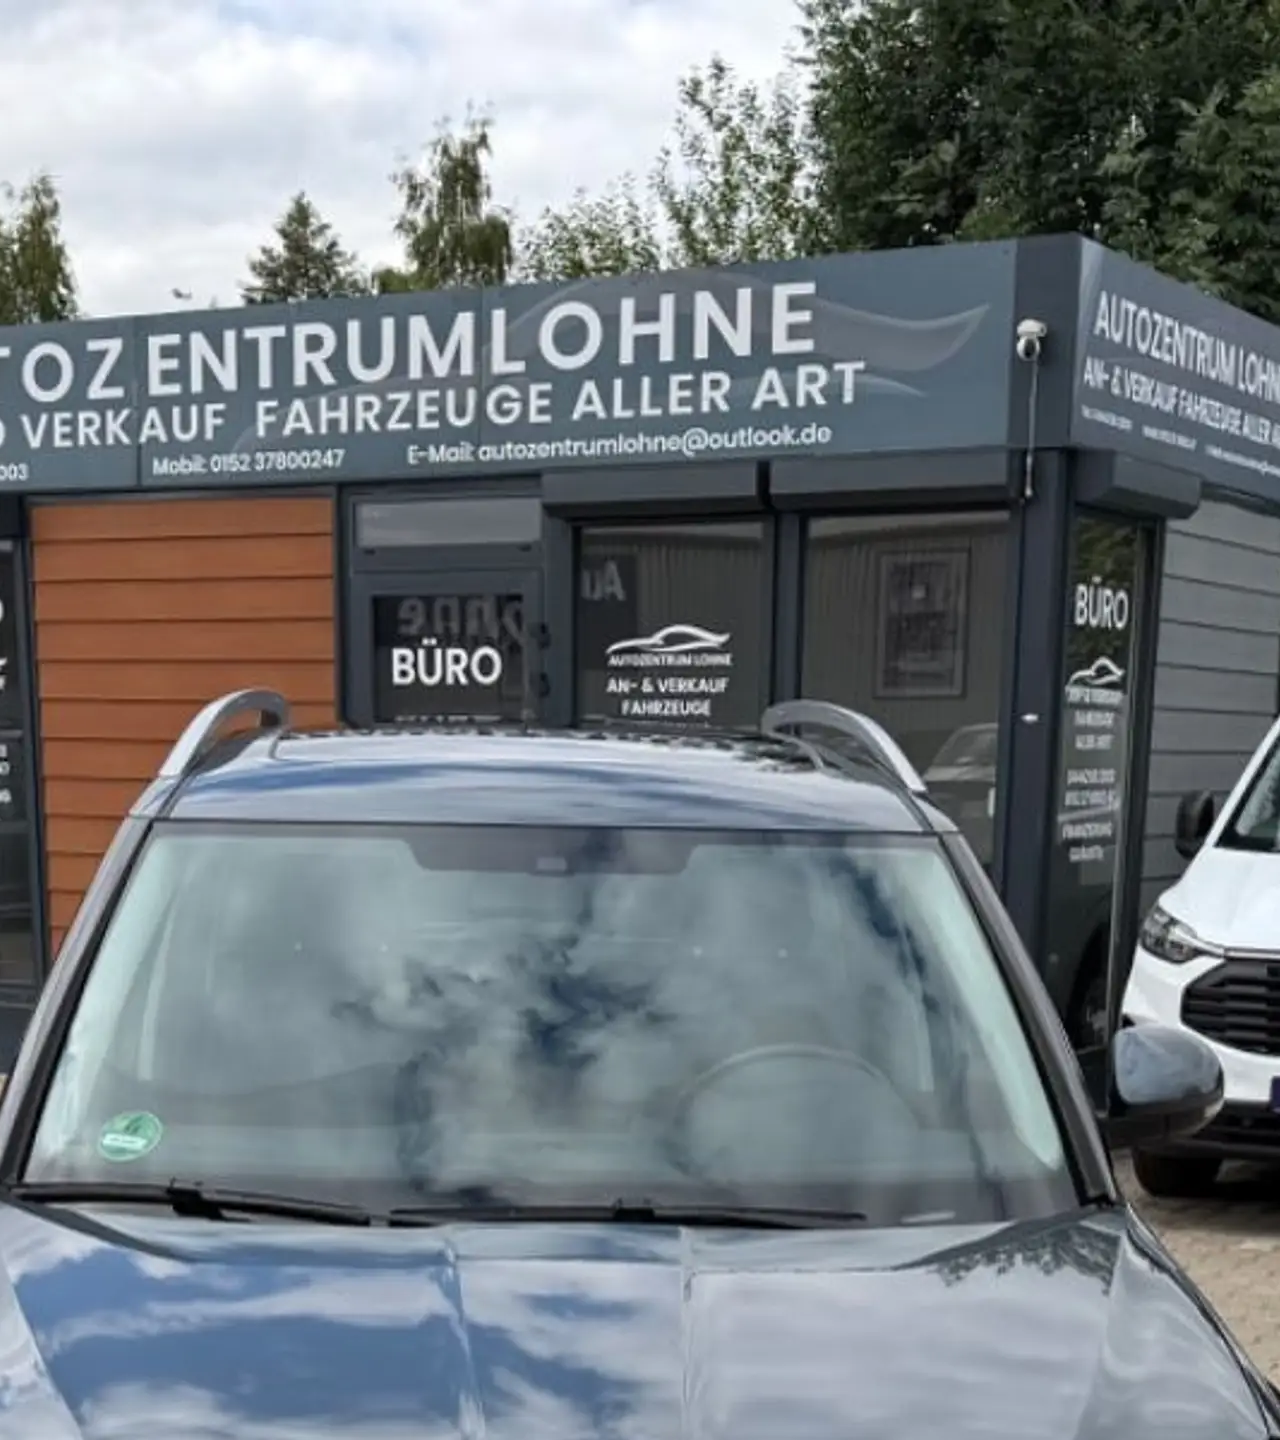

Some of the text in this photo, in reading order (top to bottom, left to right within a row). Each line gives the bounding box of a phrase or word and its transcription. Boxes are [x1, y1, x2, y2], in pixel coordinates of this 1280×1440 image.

[1093, 289, 1236, 386] AUTOZENTRUM
[20, 402, 227, 450] VERKAUF
[255, 382, 553, 438] FAHRZEUGE
[571, 371, 732, 421] ALLER
[750, 360, 867, 409] ART
[209, 451, 252, 473] 0152
[255, 449, 347, 471] 37800247
[407, 424, 832, 465] E-Mail: autozentrumlohne@outlook.de
[1073, 575, 1129, 630] BÜRO
[392, 637, 502, 686] BÜRO
[606, 676, 730, 694] AN- & VERKAUF
[621, 699, 711, 716] FAHRZEUGE
